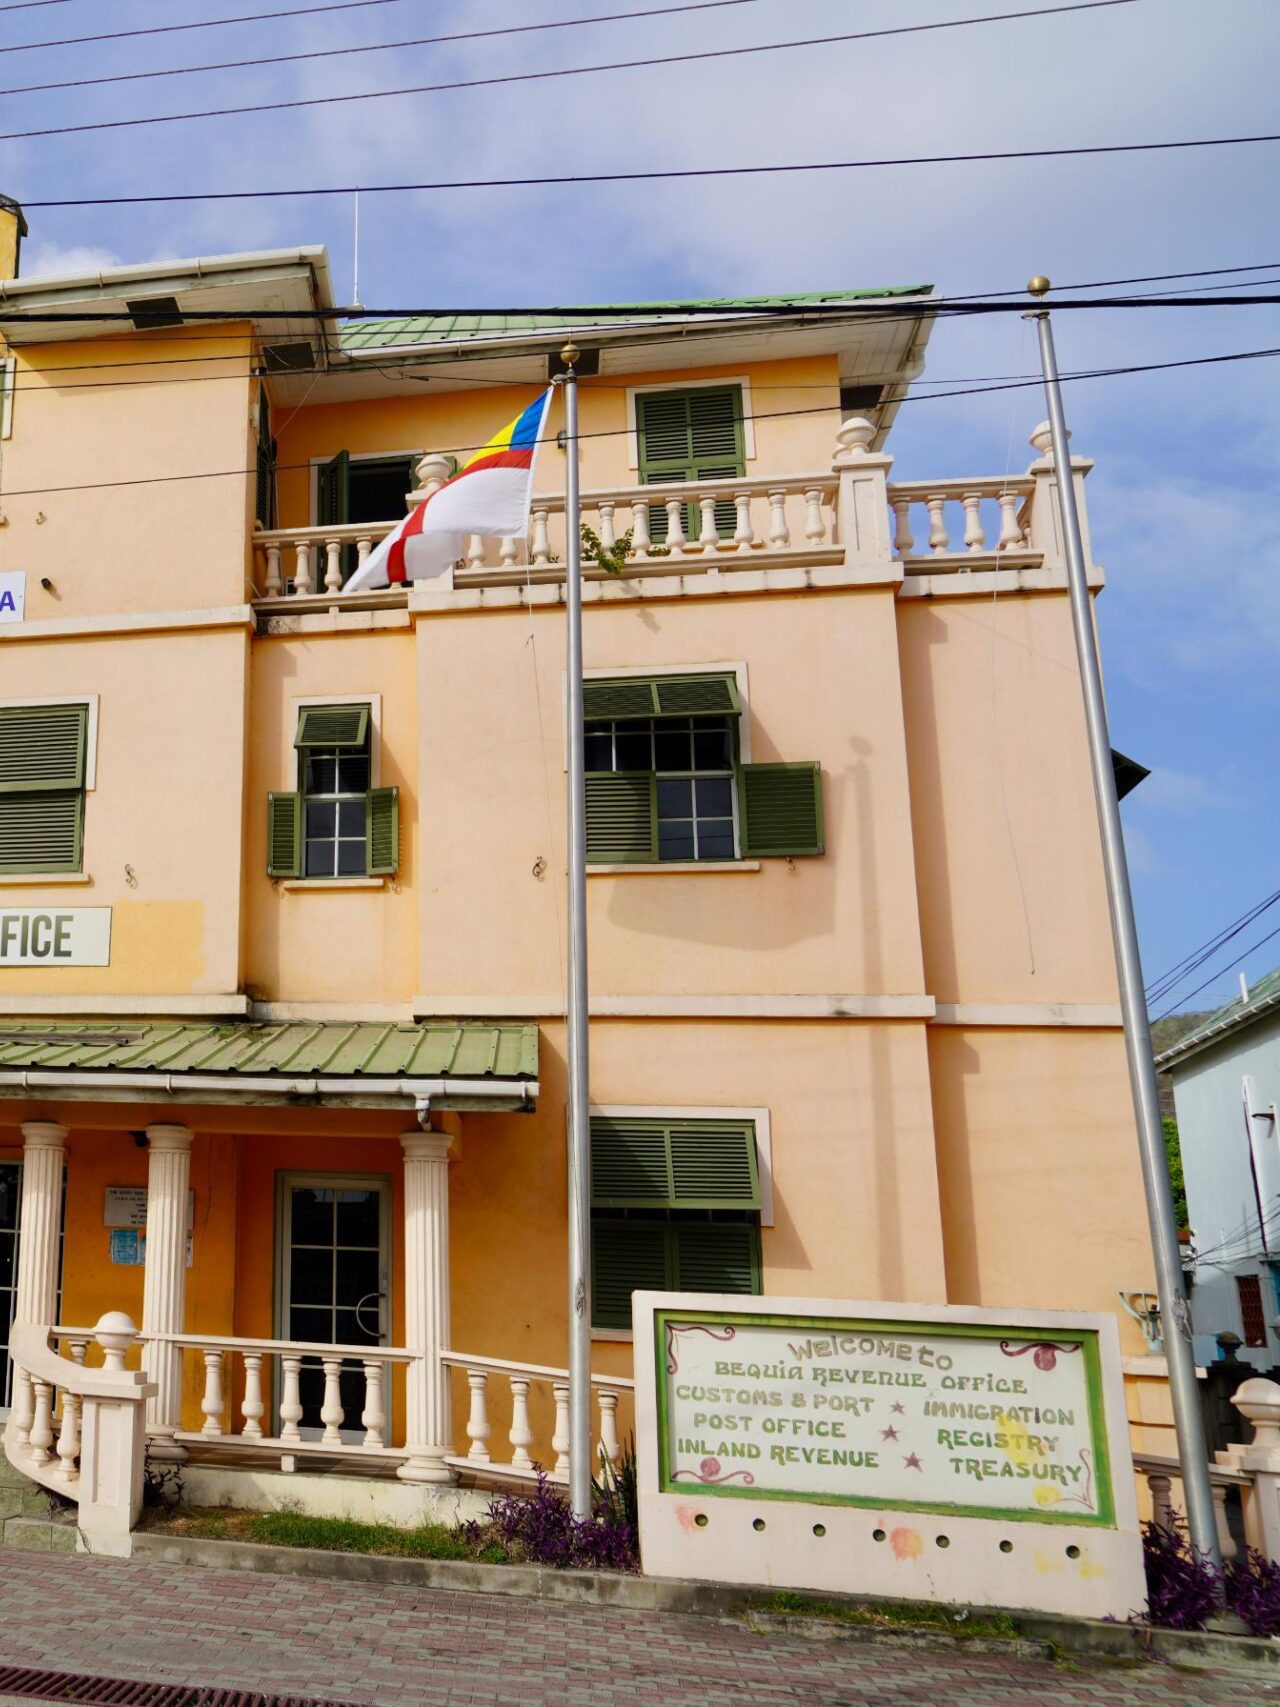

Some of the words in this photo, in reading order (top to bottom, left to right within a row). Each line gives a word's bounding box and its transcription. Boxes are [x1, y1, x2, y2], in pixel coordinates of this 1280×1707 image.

[811, 1366, 927, 1388] REVENUE
[675, 1384, 783, 1408] CUSTOMS
[813, 1393, 876, 1418] PORT
[923, 1400, 1075, 1427] IMMIGRATION
[693, 1413, 753, 1432] POST
[761, 1418, 846, 1439] OFFICE
[677, 1437, 761, 1459] INLAND
[770, 1444, 880, 1468] REVENUE
[937, 1428, 1059, 1457] REGISTRY
[949, 1457, 1082, 1487] TREASURY
